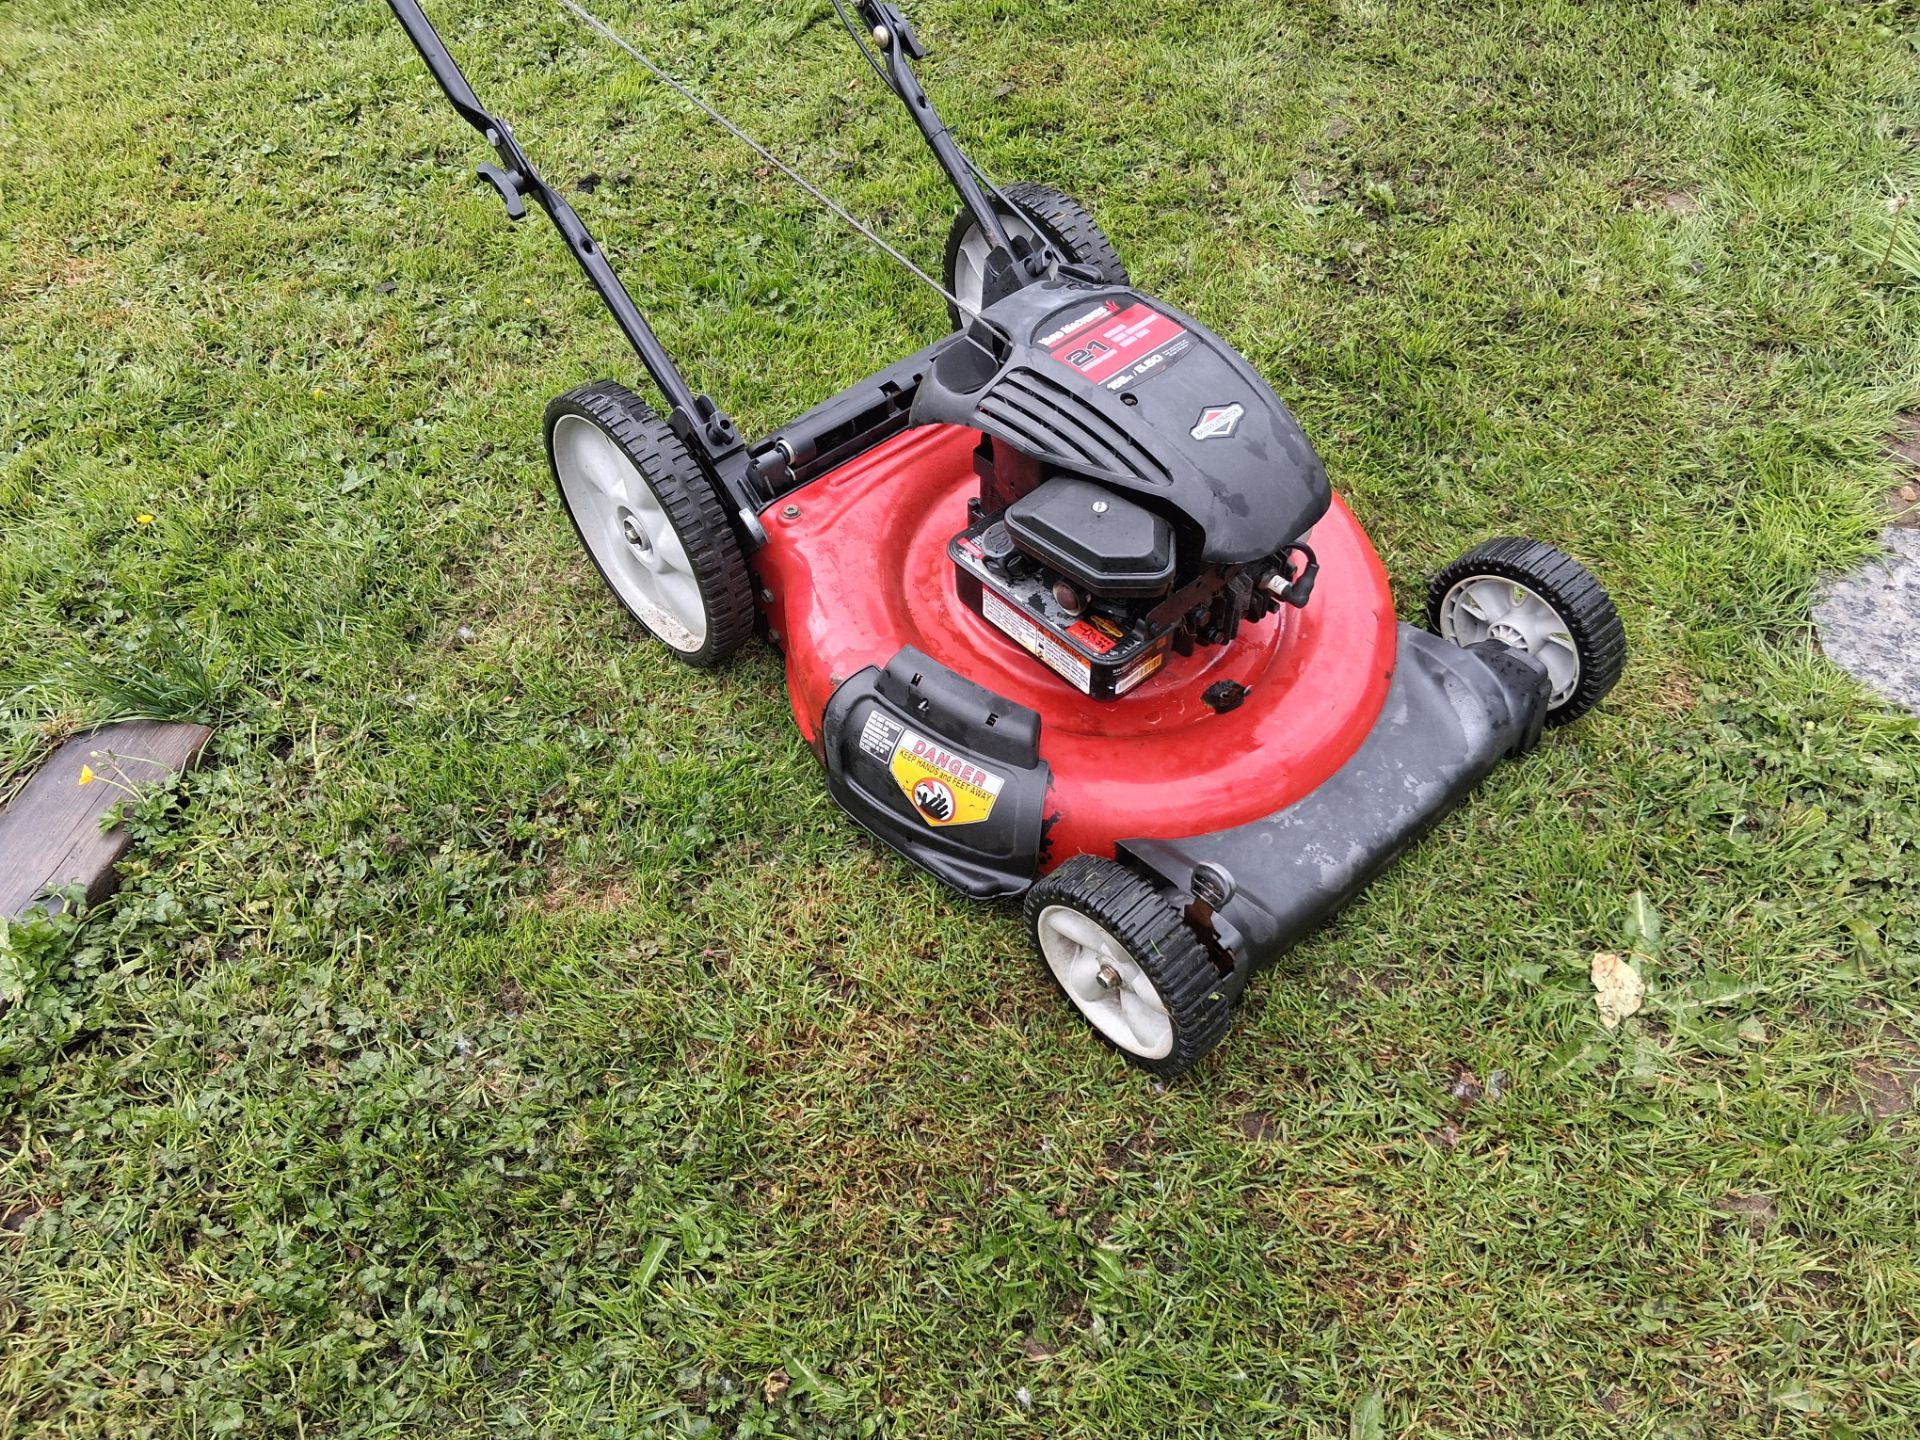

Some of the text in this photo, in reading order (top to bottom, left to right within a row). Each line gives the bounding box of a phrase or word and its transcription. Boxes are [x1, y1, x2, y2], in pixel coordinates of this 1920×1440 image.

[1065, 339, 1110, 367] 21
[899, 750, 993, 801] KEEP HANDS and FEET AWAY
[913, 740, 987, 787] DANGER
